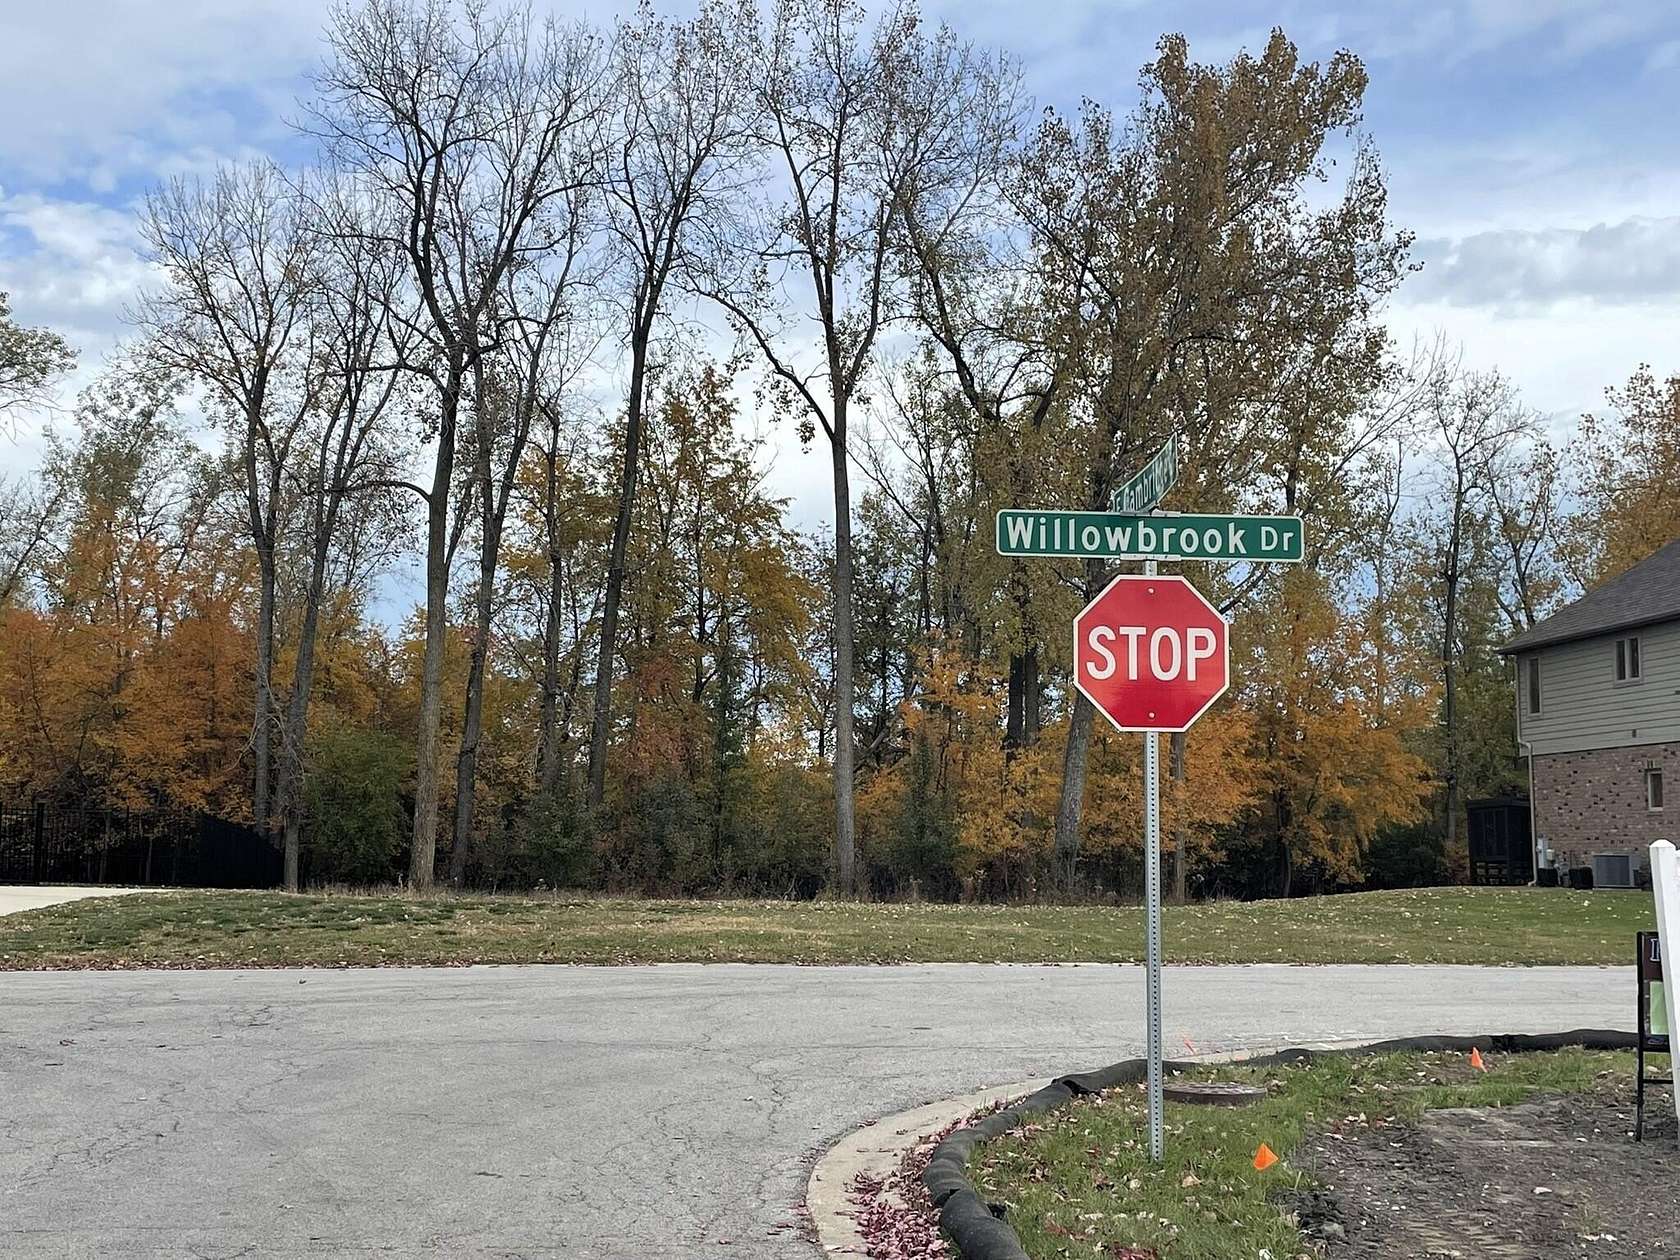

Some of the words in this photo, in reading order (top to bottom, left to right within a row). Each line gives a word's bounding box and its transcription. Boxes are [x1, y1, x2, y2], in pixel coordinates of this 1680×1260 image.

[1006, 516, 1247, 554] Willowbrook
[1261, 526, 1295, 551] Dr
[1086, 625, 1217, 681] STOP
